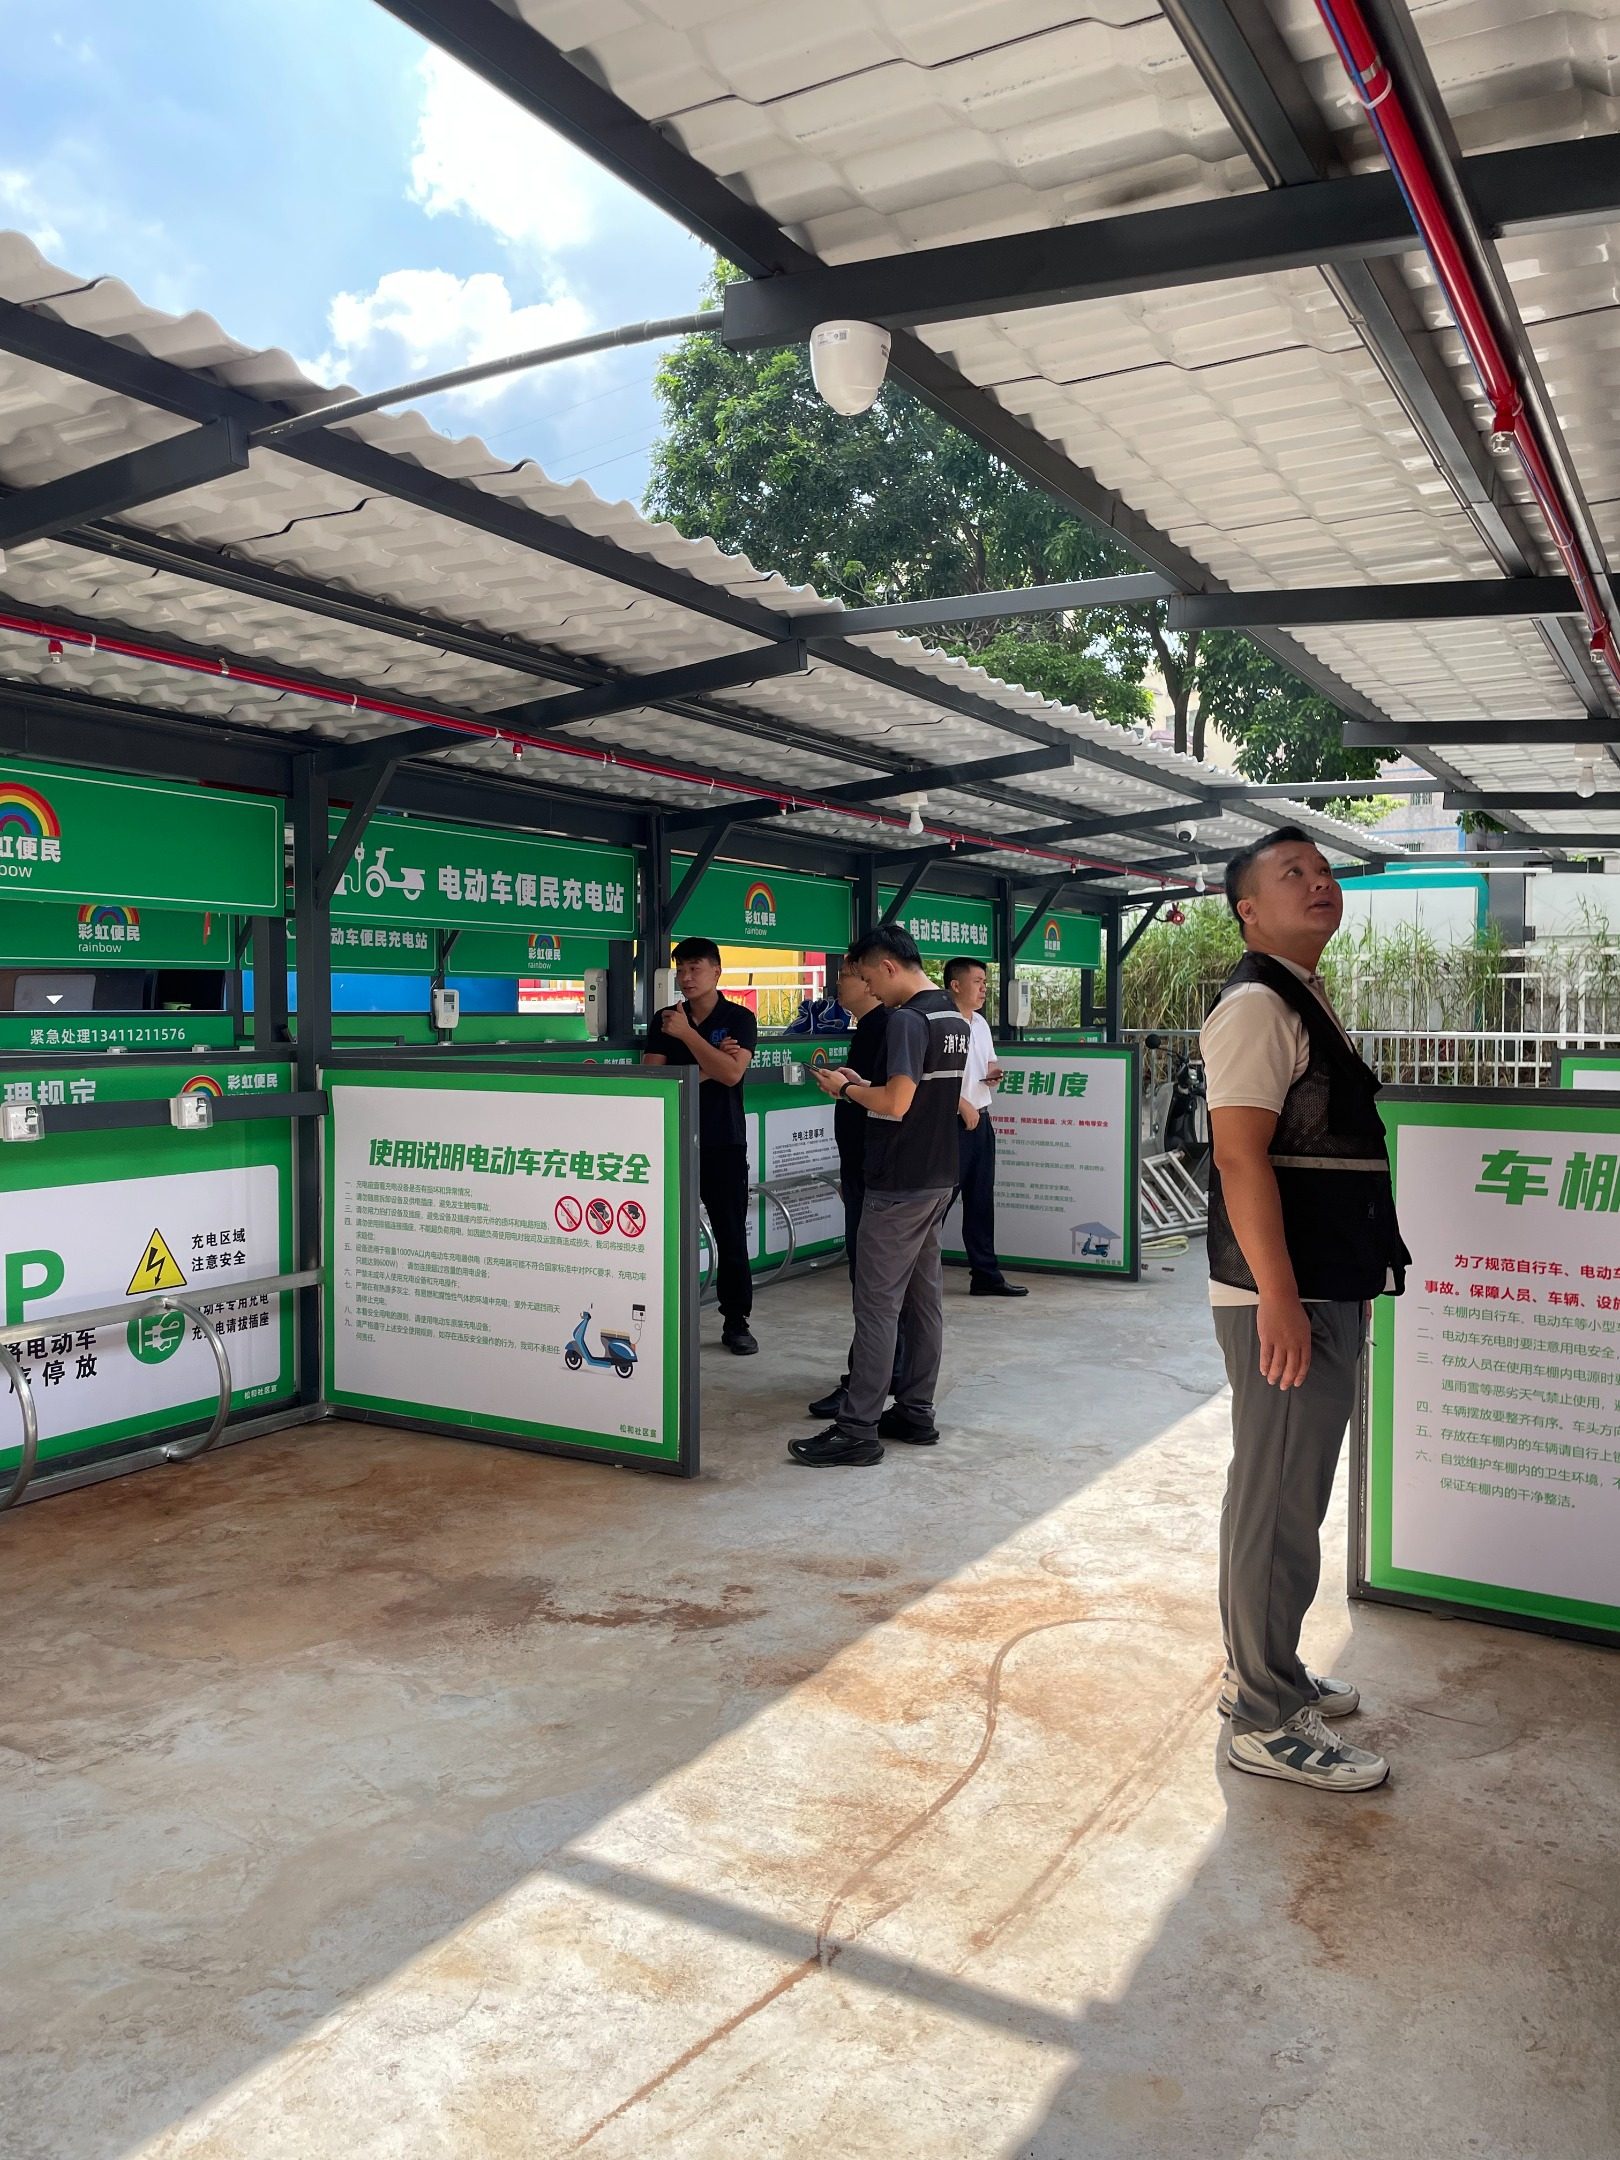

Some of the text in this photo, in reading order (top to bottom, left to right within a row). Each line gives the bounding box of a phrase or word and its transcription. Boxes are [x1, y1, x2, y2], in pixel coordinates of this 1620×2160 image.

[438, 865, 625, 913] 电动车便民充电站
[745, 910, 776, 927] 彩虹便民
[78, 924, 140, 941] 彩虹便民
[331, 928, 428, 949] 动车便民充电站
[909, 918, 988, 945] 电动车便民充电站
[78, 942, 122, 953] rainbow
[528, 947, 561, 961] 彩虹便民
[30, 1028, 185, 1045] 紧急处理13411211576
[227, 1073, 278, 1090] 彩虹便民
[369, 1138, 651, 1184] 使用说明电动车充电安全
[1475, 1149, 1620, 1212] 车棚
[192, 1228, 246, 1250] 充电区域
[192, 1250, 247, 1272] 注意安全
